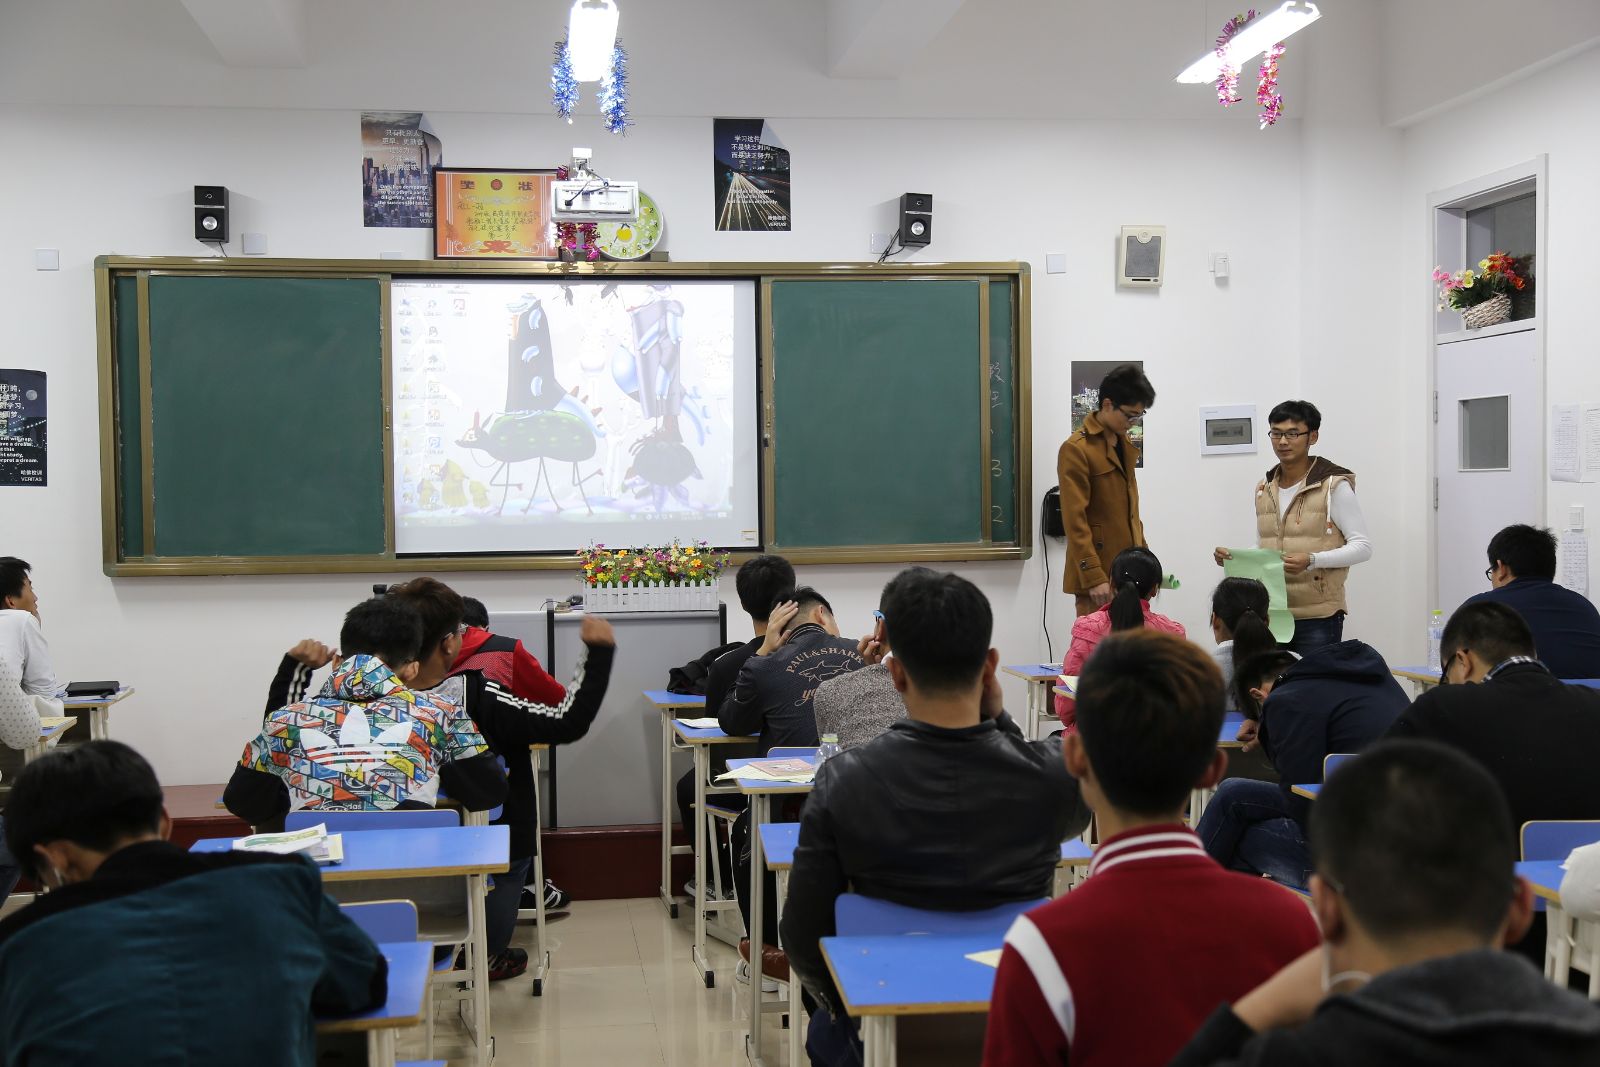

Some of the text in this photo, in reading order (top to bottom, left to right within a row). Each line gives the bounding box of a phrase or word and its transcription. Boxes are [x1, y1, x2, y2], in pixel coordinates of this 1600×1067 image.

[991, 459, 1002, 477] 3
[992, 505, 1003, 522] 2
[786, 647, 863, 673] PAUL&SHARK
